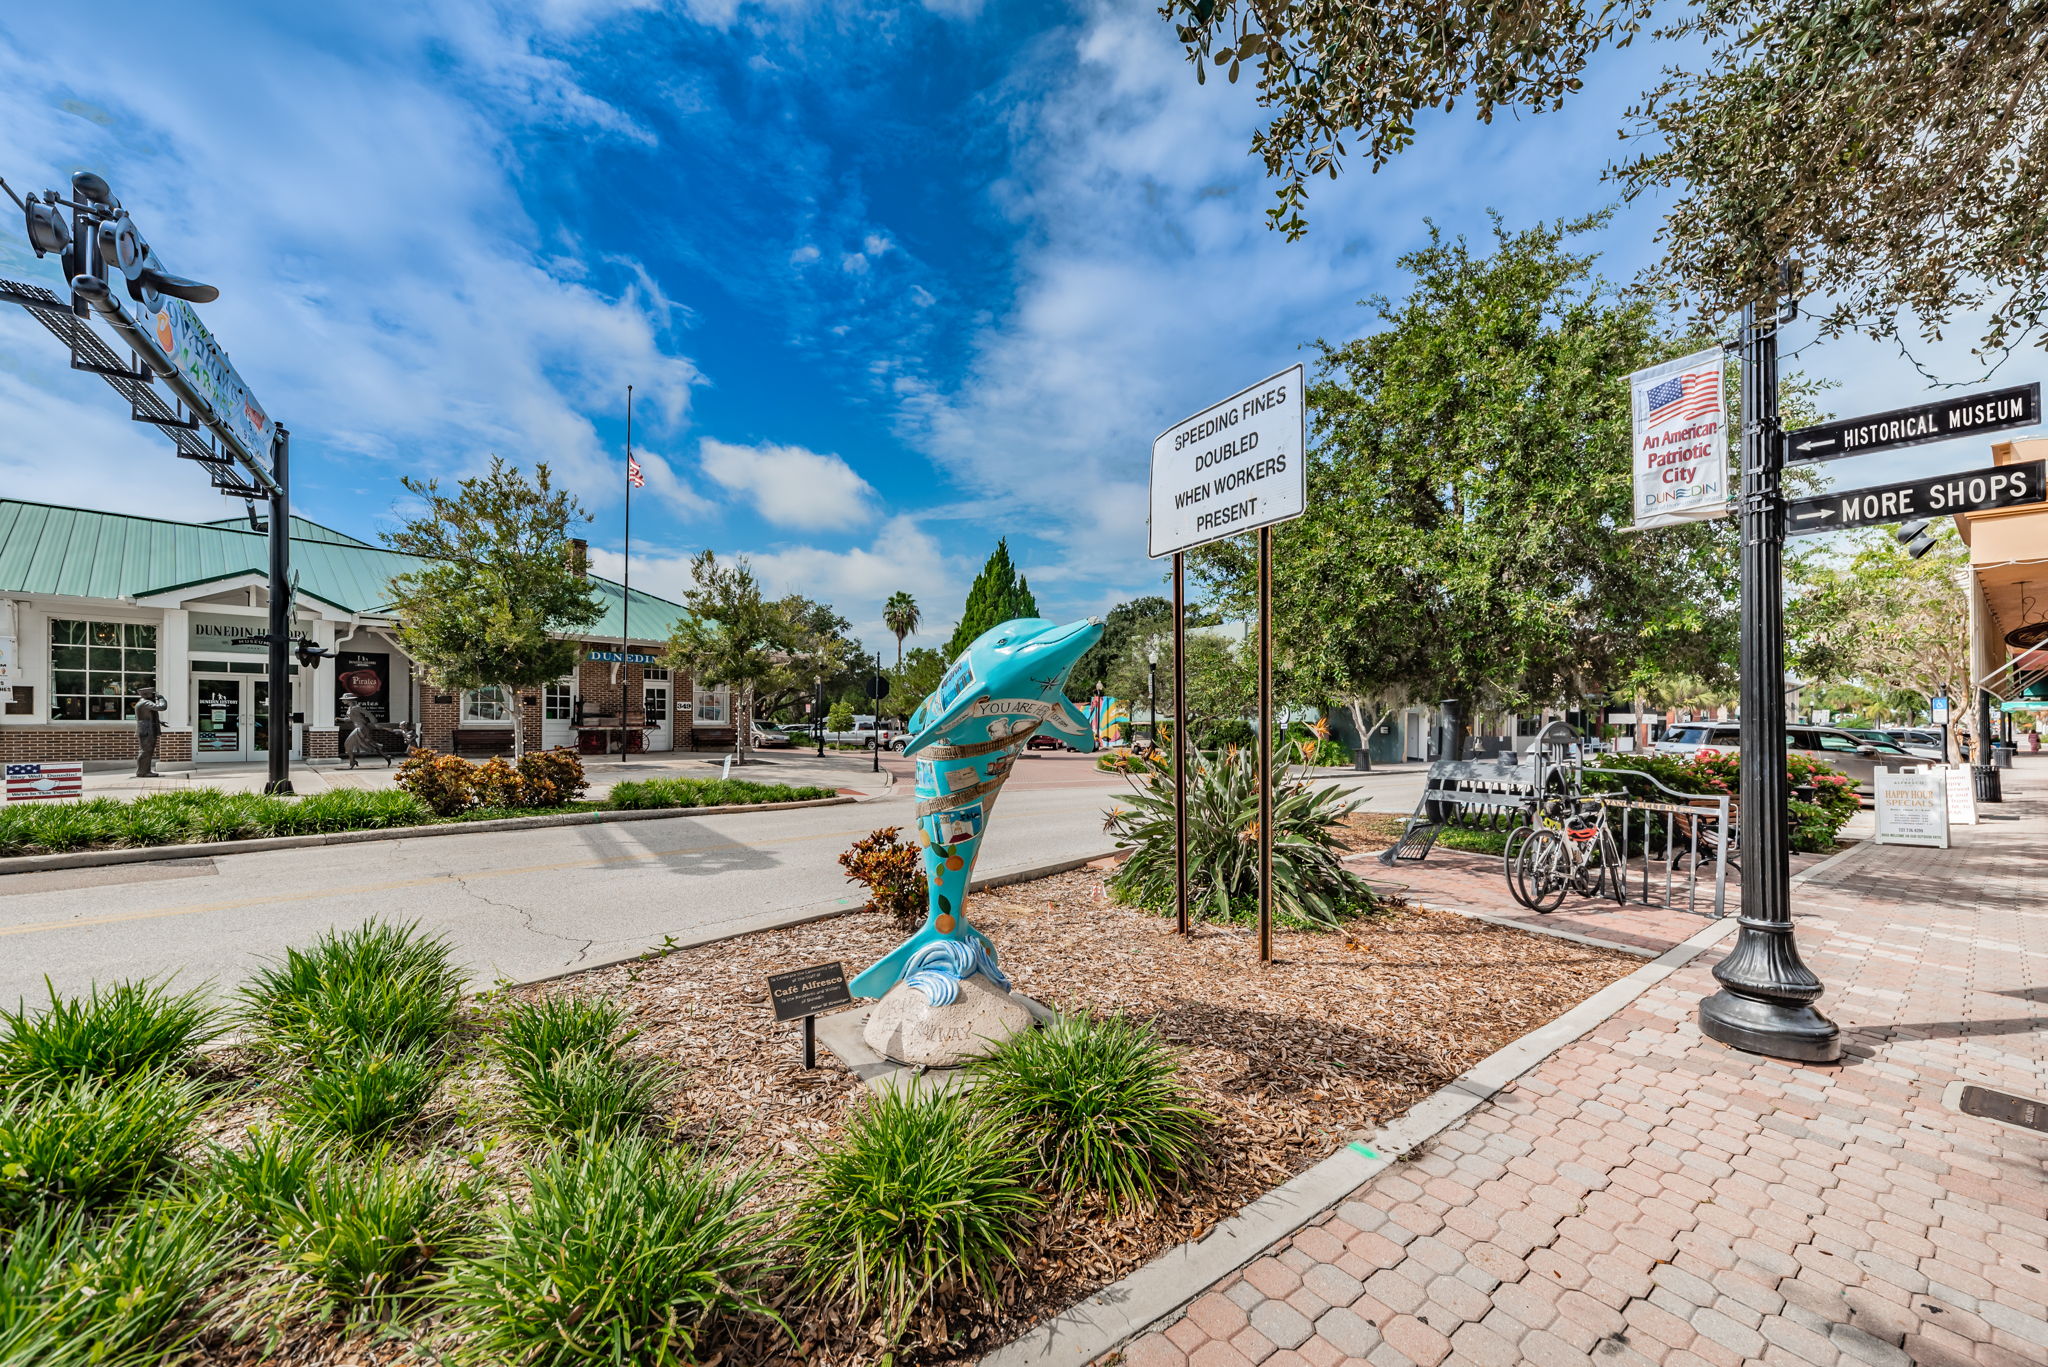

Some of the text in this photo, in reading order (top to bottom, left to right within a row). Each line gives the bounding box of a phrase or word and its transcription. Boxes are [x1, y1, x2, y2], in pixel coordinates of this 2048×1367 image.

[1174, 386, 1287, 451] SPEEDING FINES
[1844, 397, 2023, 448] HISTORICAL MUSEUM
[1643, 422, 1717, 450] An American
[1195, 431, 1259, 472] DOUBLED
[1648, 443, 1712, 468] Patriotic
[1174, 454, 1287, 510] WHEN WORKERS
[1662, 467, 1697, 484] City
[1646, 482, 1717, 505] DUNEDIN
[1842, 472, 2027, 523] MORE SHOPS
[1197, 497, 1258, 532] PRESENT
[196, 624, 253, 637] DUNEDIN
[352, 676, 377, 685] Pirates
[980, 702, 1010, 715] YOU
[1012, 702, 1035, 713] ARE
[1885, 790, 1934, 799] HAPPY HOUR
[774, 976, 843, 998] Café Alfresco
